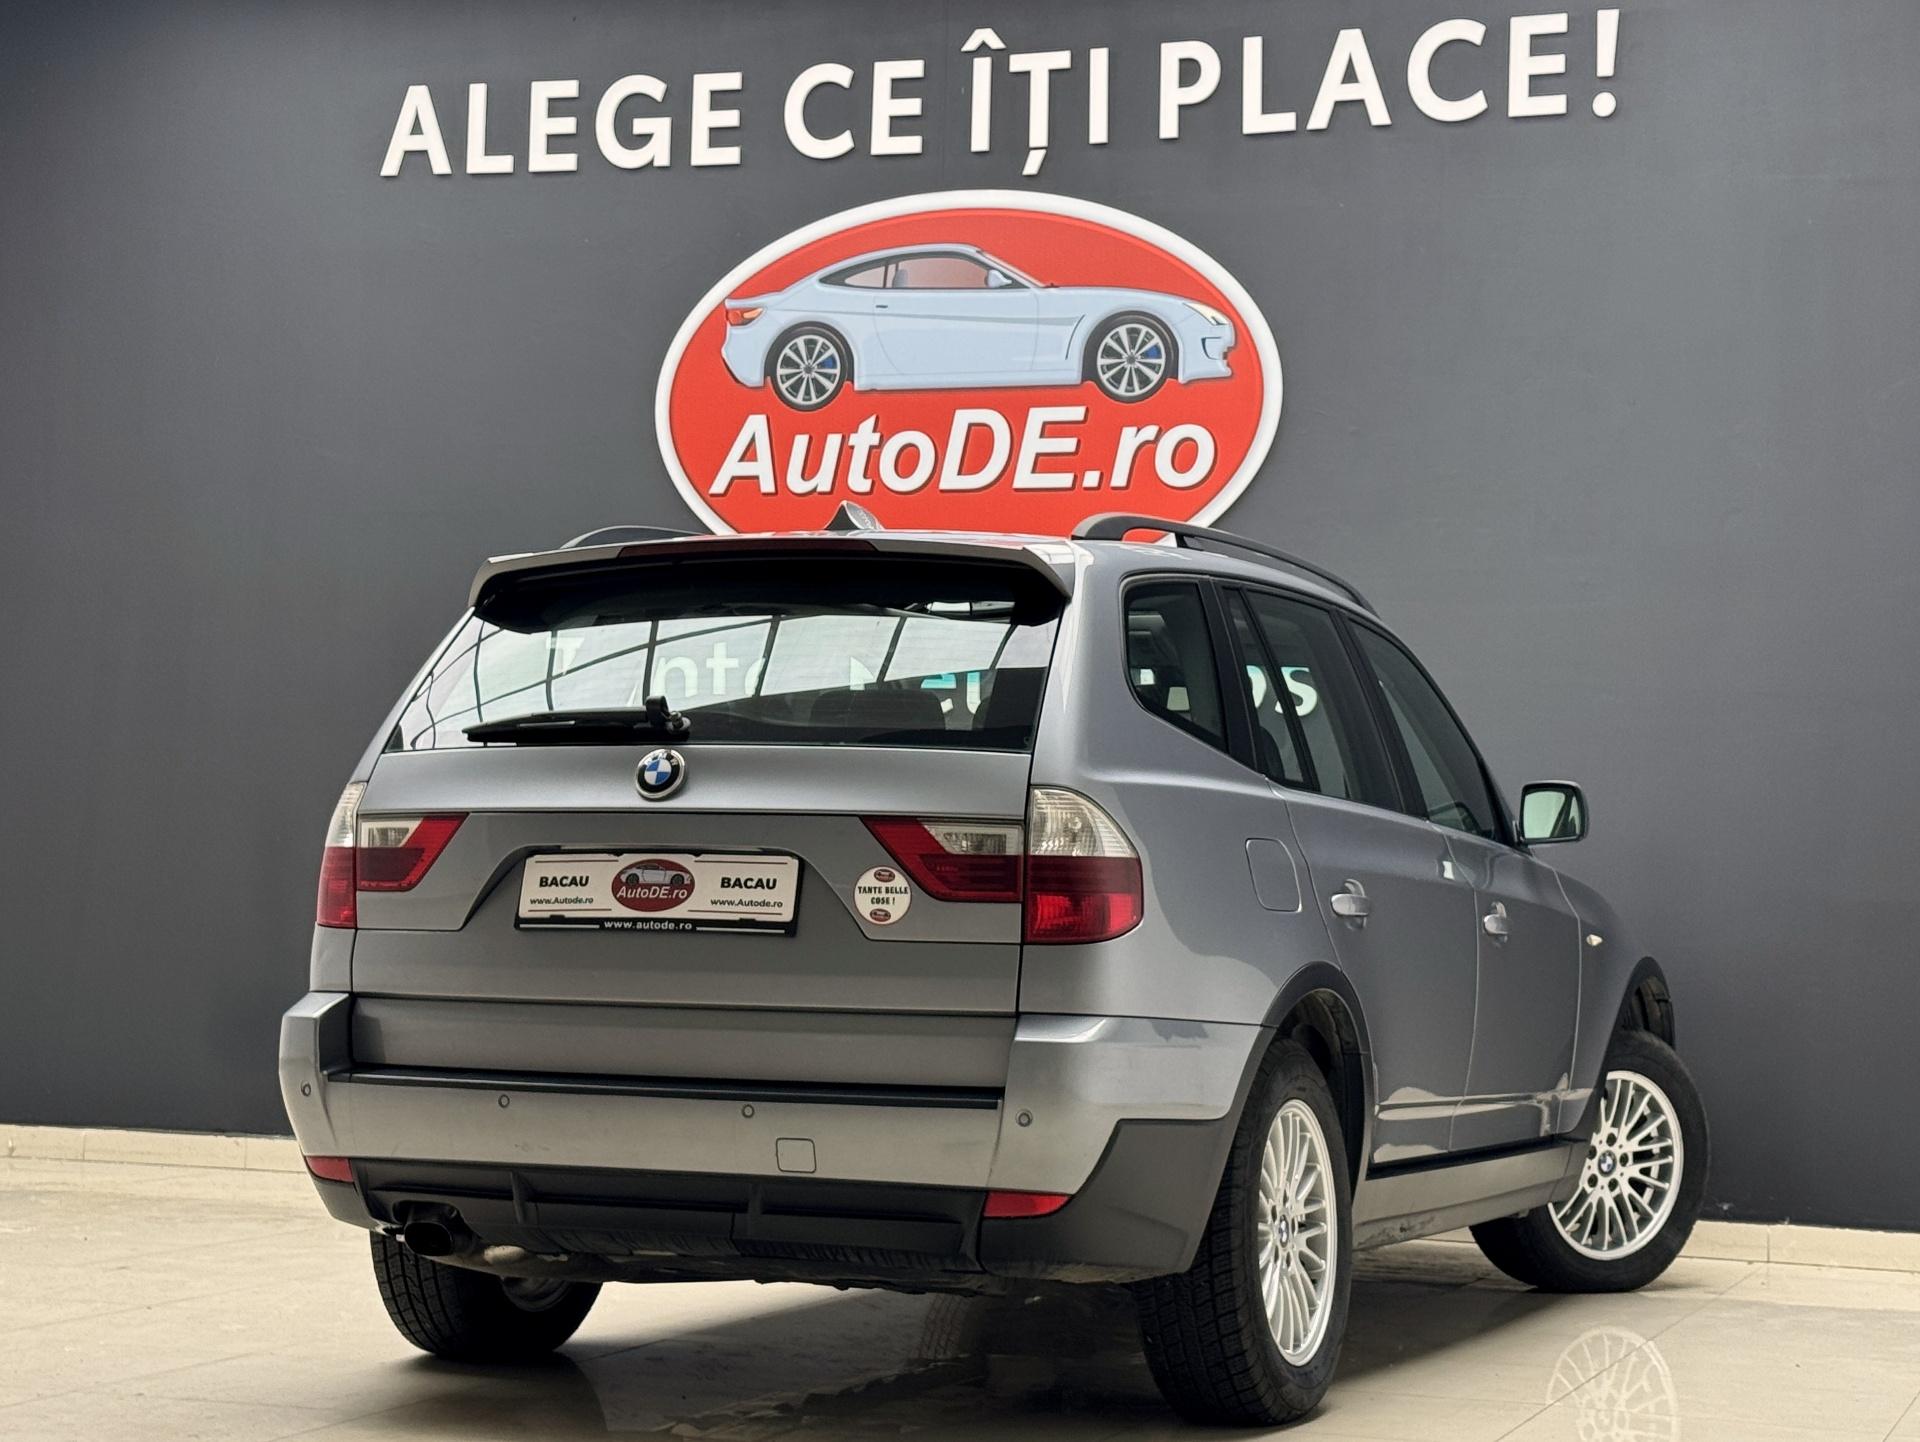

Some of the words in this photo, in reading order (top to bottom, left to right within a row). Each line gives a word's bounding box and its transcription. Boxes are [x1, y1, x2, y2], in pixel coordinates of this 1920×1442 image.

[380, 71, 743, 177] ALEGE
[784, 59, 925, 159] CE
[1159, 8, 1620, 140] PLACE!
[709, 405, 1215, 495] AutoDE.ro
[538, 875, 590, 888] BACAU
[720, 876, 778, 890] BACAU
[616, 885, 688, 900] AutoDE.ro
[857, 886, 883, 894] TANTE
[884, 886, 909, 895] BELLE
[529, 895, 594, 906] www.Autode.ro
[709, 898, 784, 909] www.Autode.ro
[870, 897, 890, 905] COSE
[604, 920, 693, 931] www.autode.ro
